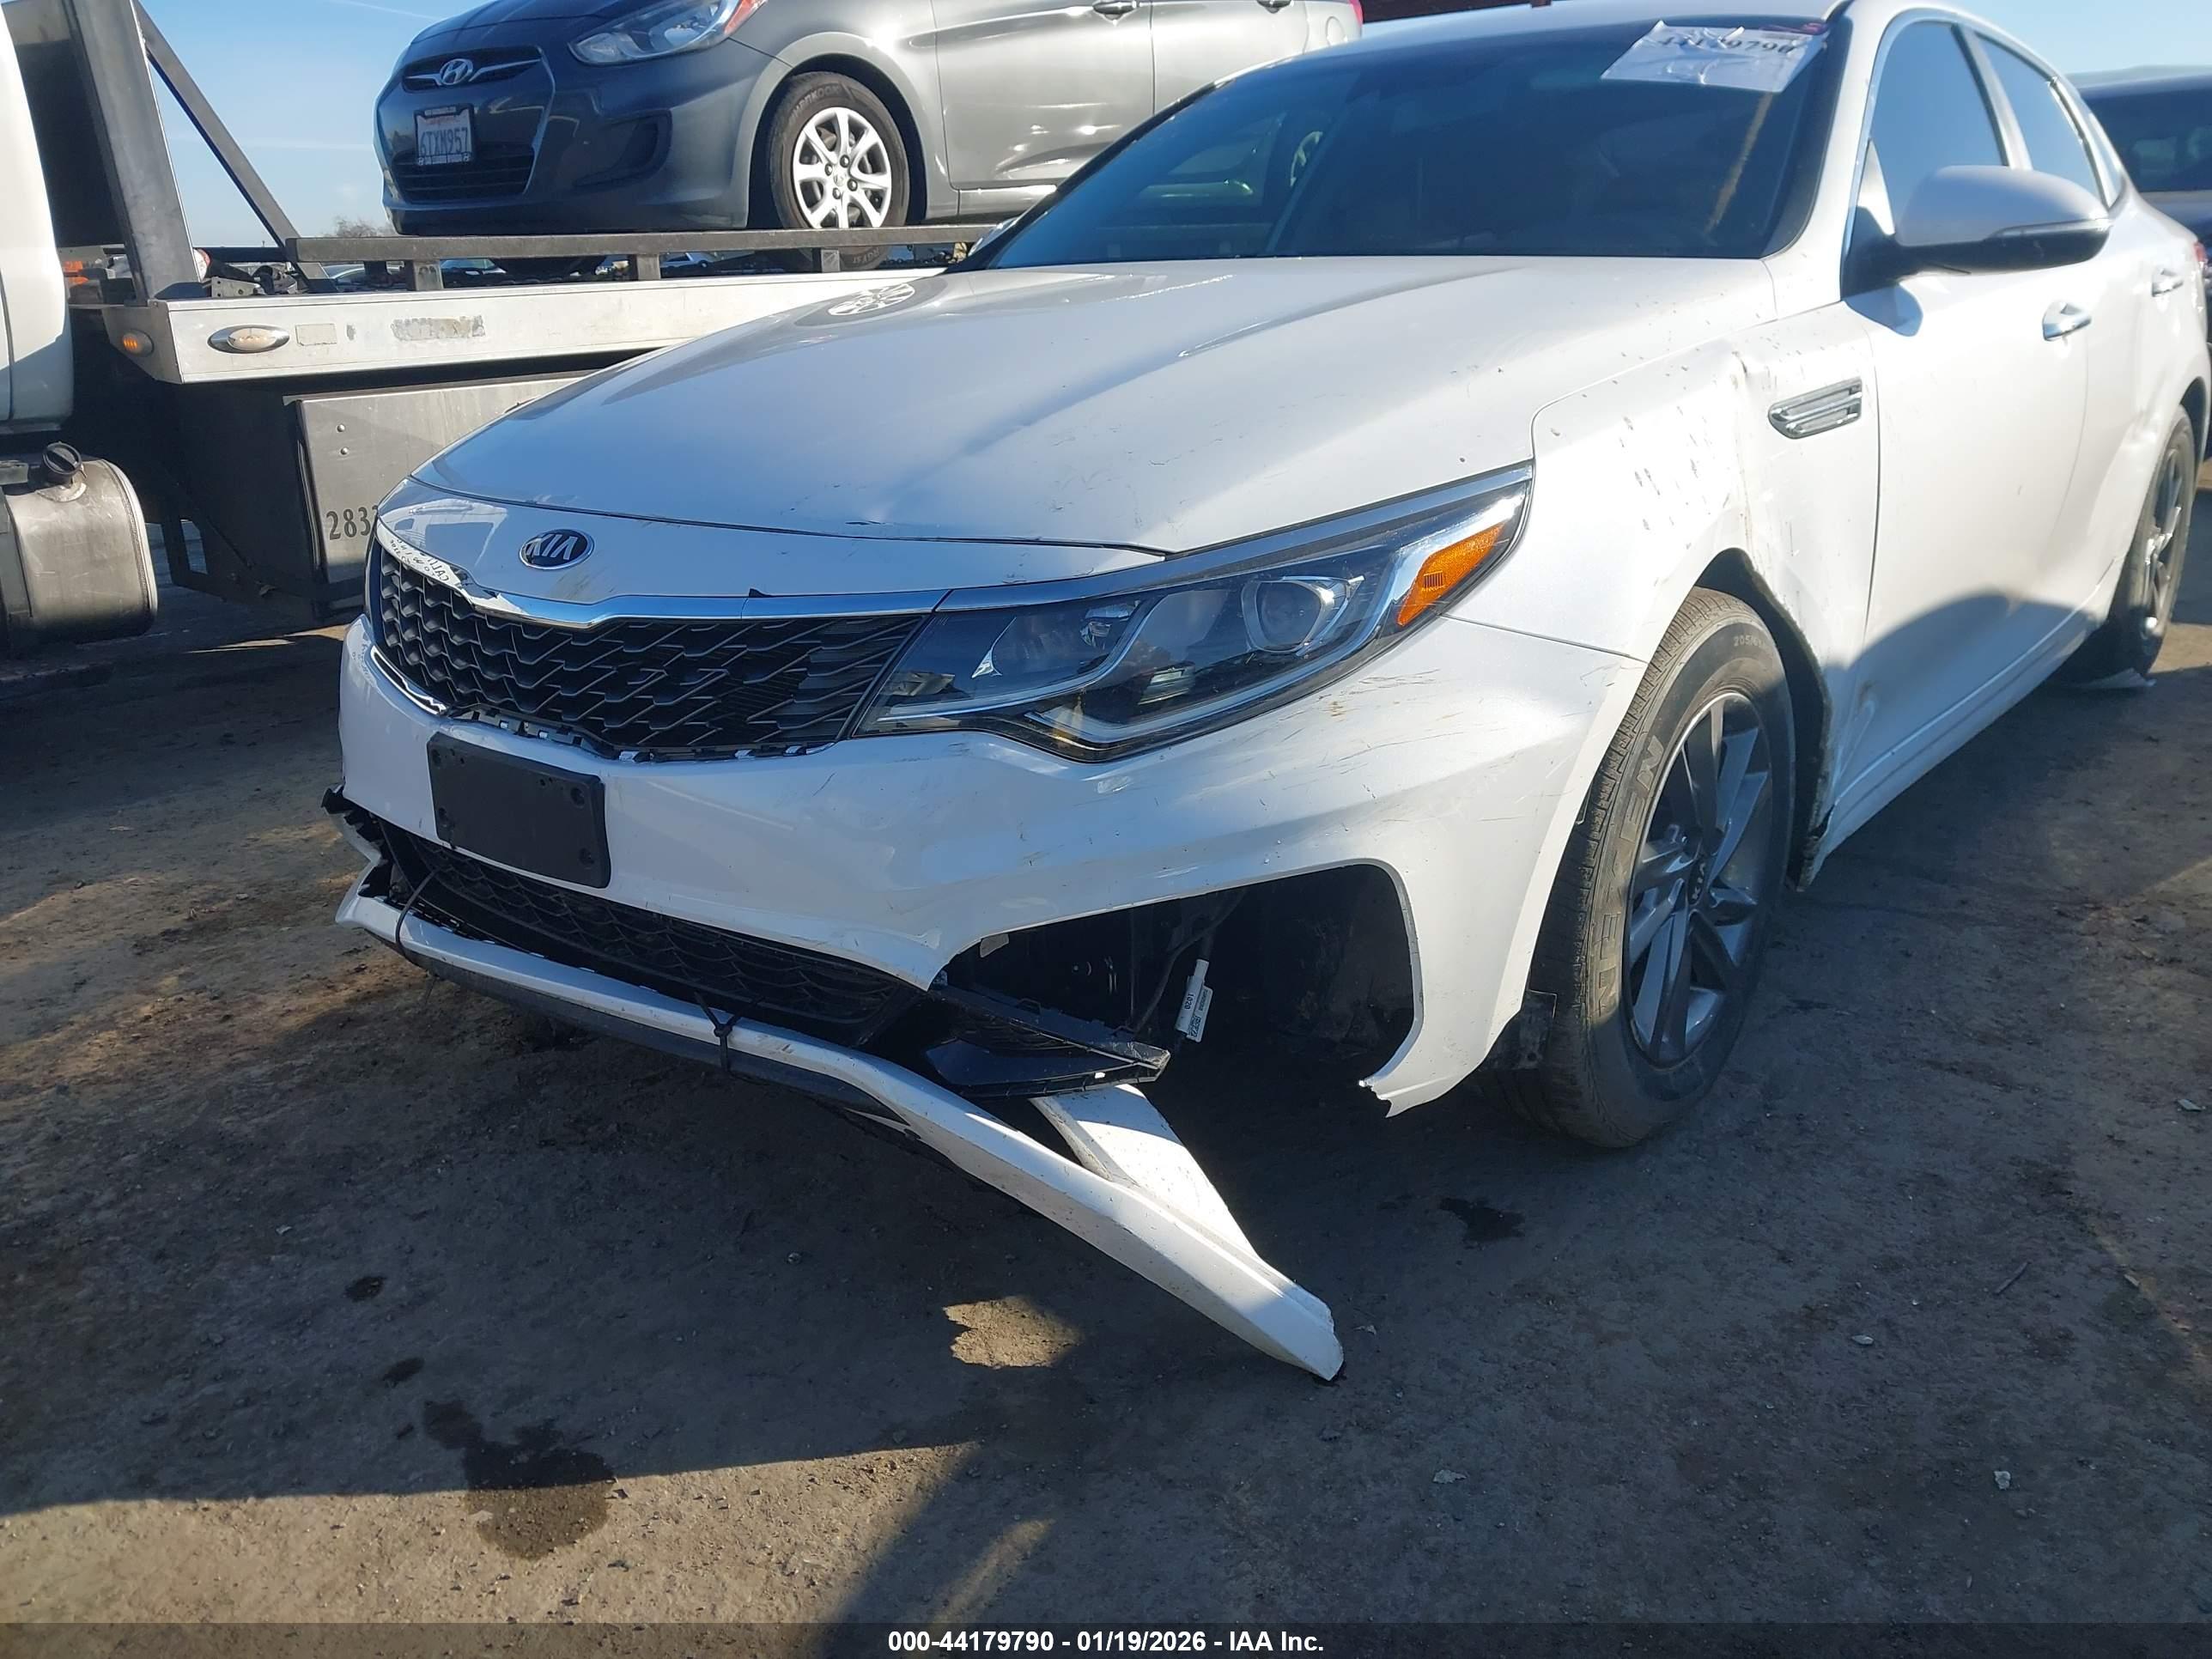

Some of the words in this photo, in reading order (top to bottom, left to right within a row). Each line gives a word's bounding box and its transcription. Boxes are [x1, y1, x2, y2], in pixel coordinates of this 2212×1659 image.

[325, 504, 379, 541] 283
[526, 533, 579, 561] KIA
[1596, 734, 1665, 1018] NEXEN
